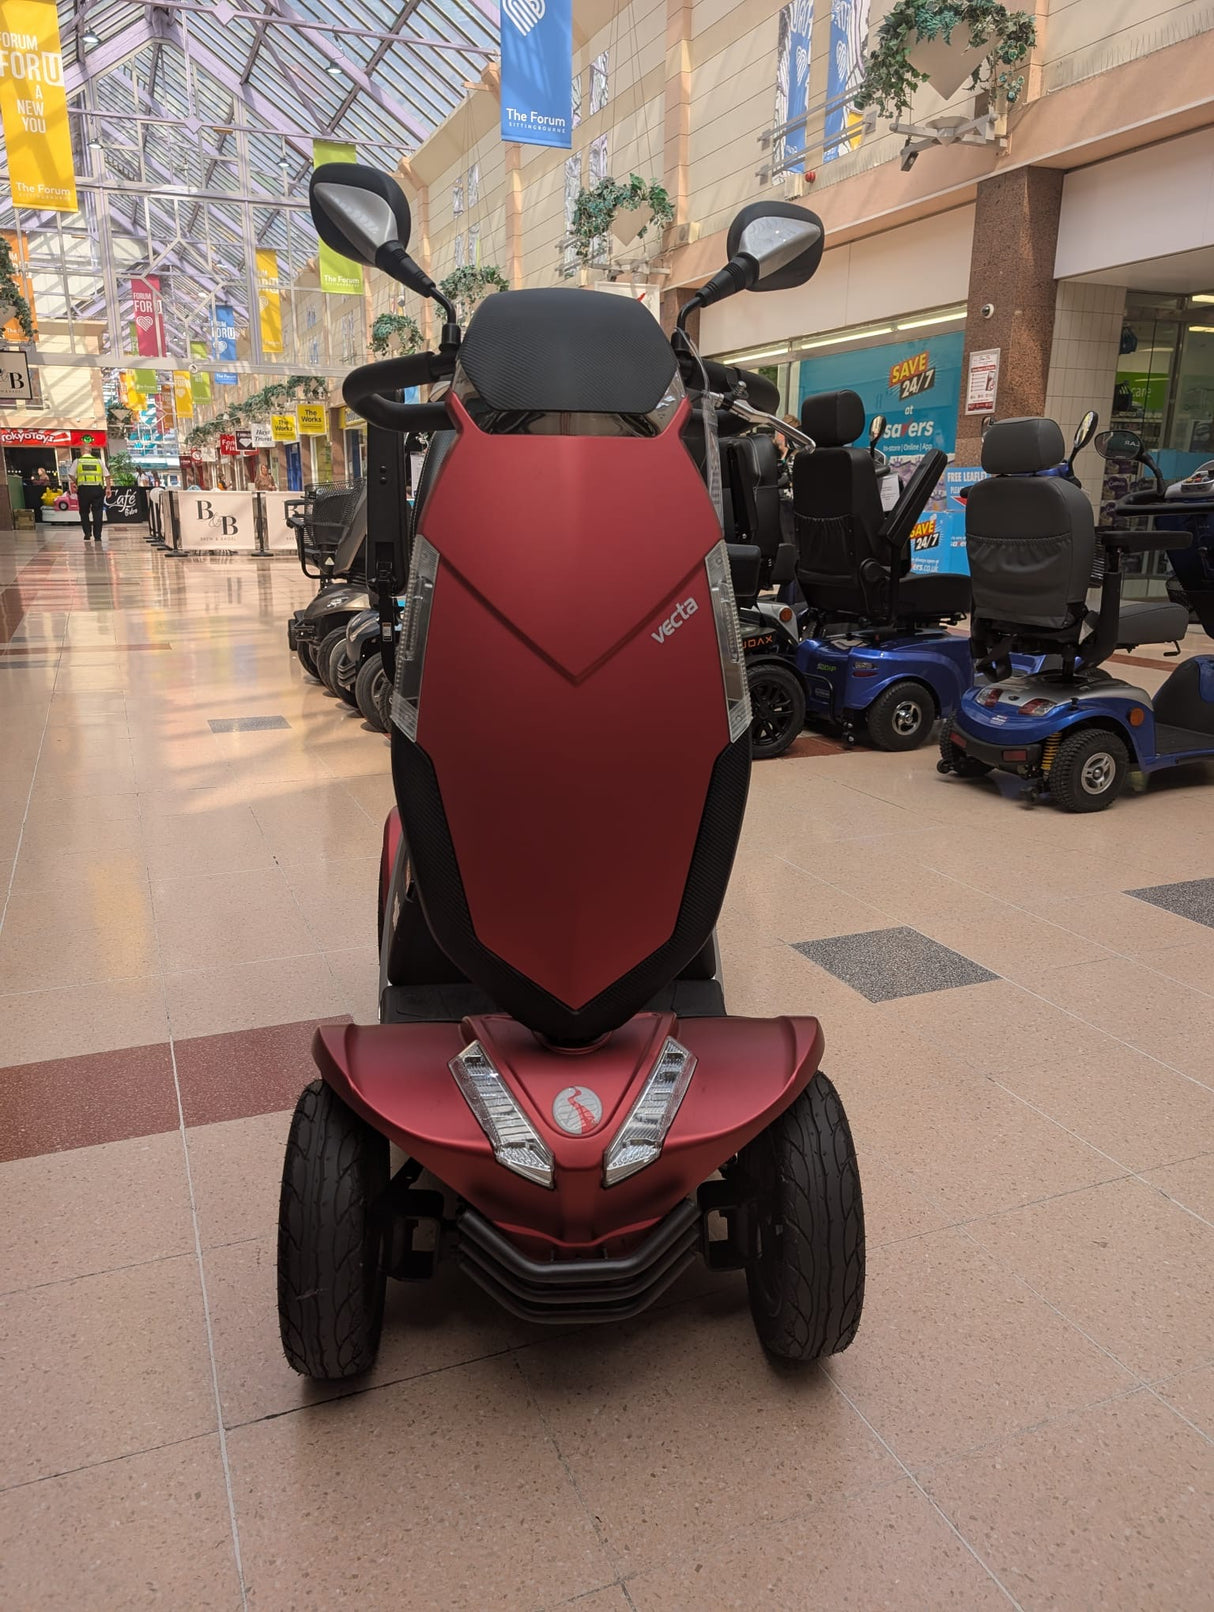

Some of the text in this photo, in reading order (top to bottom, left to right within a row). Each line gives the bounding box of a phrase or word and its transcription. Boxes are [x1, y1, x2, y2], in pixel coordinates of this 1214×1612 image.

[0, 32, 38, 51] ORUM
[35, 84, 43, 99] A
[16, 99, 44, 116] NEW
[21, 116, 46, 133] YOU
[506, 107, 565, 127] The Forum
[15, 181, 70, 196] The Forum
[324, 275, 360, 284] The Forum
[892, 353, 927, 383] SAVE
[901, 369, 935, 398] 24/7
[904, 405, 914, 415] at
[883, 420, 934, 438] savers
[947, 472, 961, 482] FREE
[915, 533, 939, 550] 24/7
